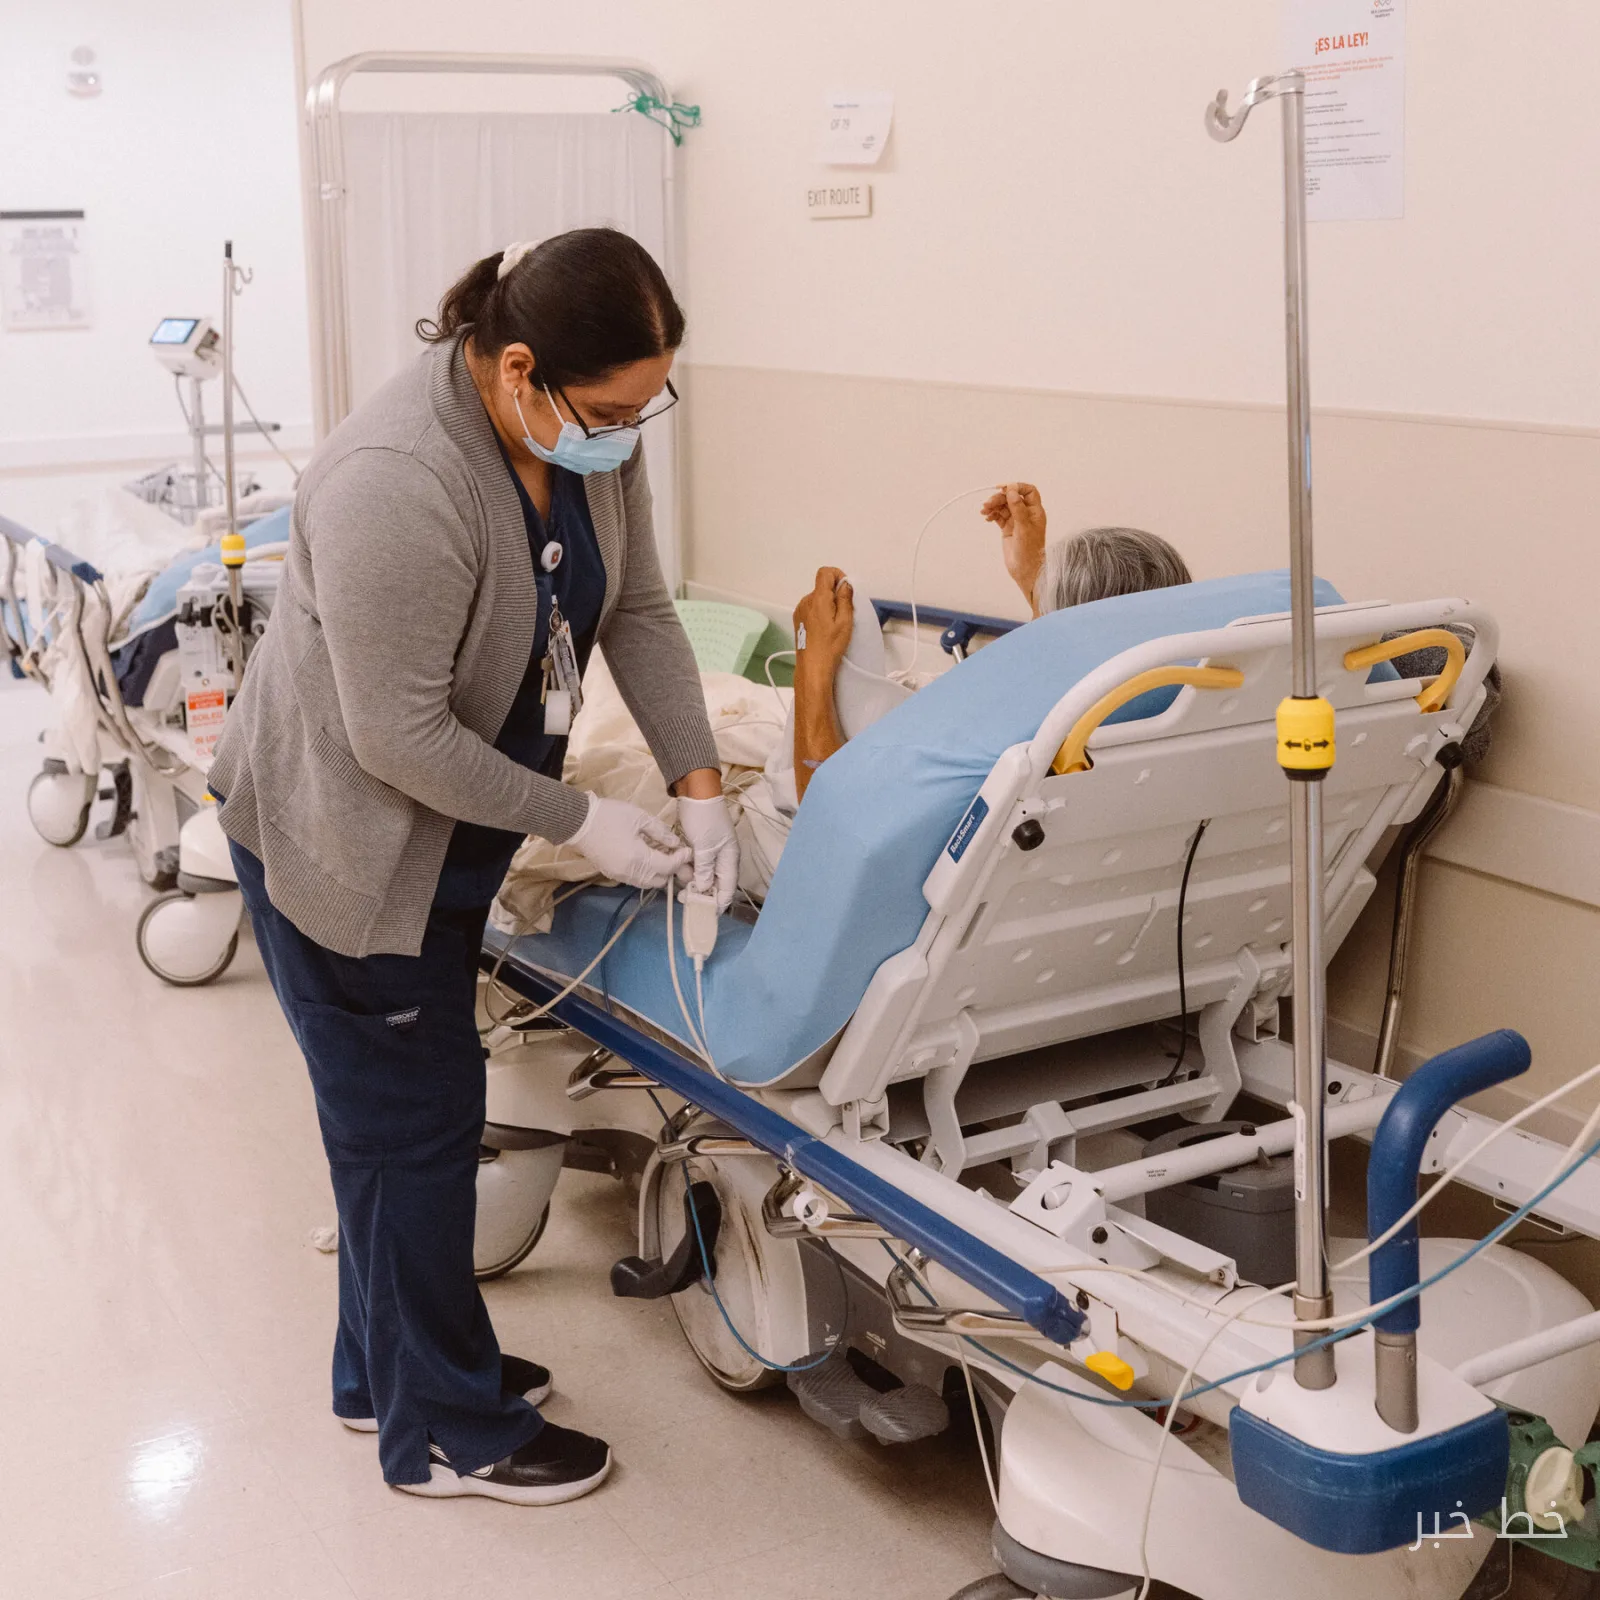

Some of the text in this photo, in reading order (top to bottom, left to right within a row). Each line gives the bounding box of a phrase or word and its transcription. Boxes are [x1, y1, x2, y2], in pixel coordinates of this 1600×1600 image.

[1315, 32, 1369, 55] ¡ES LA LEY!
[808, 187, 861, 207] EXIT ROUTE
[950, 814, 976, 854] BackSmart
